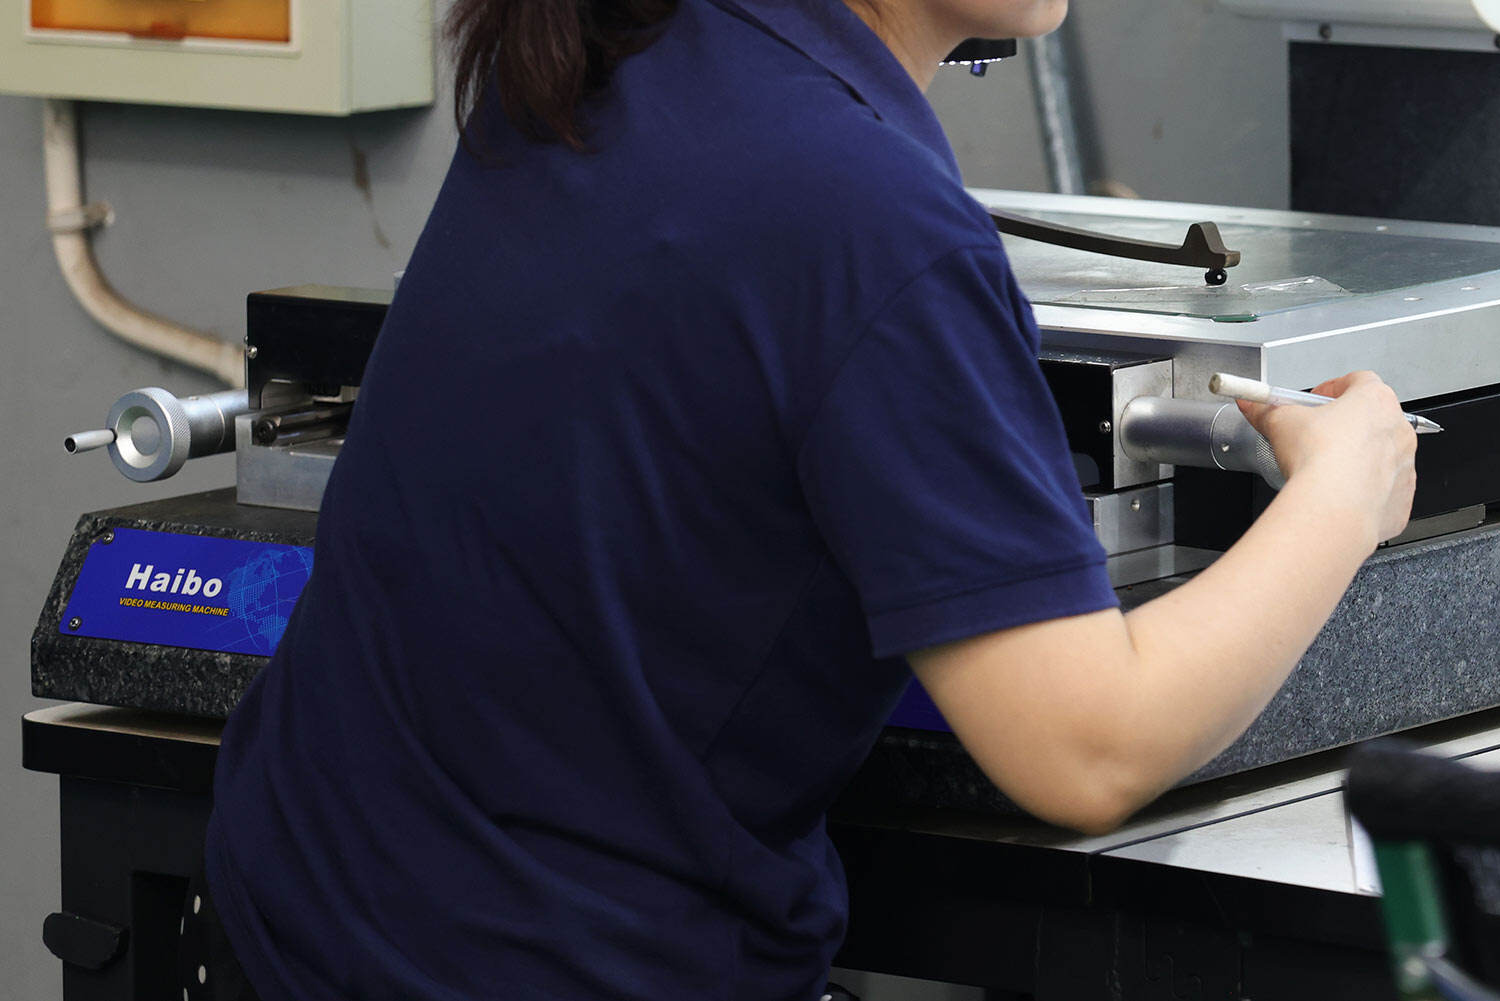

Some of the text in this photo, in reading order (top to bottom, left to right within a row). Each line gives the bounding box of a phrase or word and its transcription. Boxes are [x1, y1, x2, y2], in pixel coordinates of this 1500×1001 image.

[124, 562, 223, 598] Haibo
[119, 597, 230, 617] VIDEO MEASURING MACHINE
